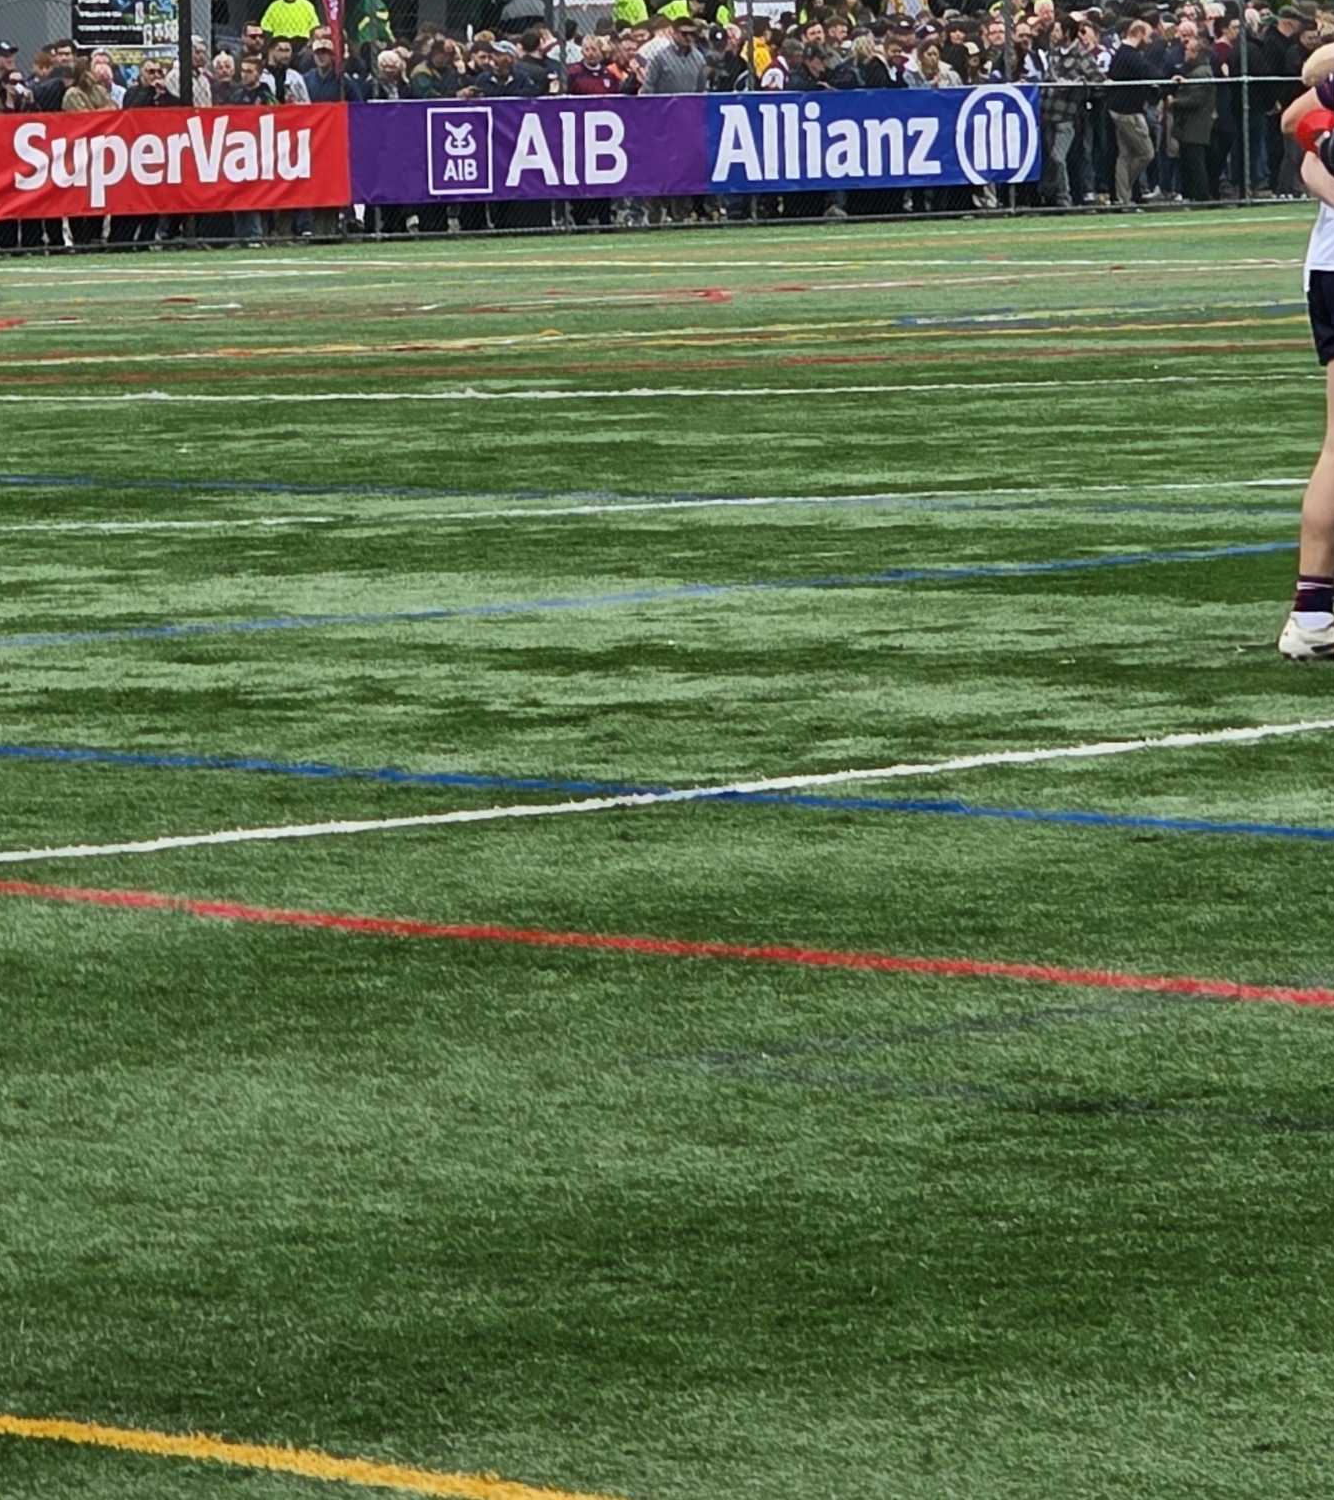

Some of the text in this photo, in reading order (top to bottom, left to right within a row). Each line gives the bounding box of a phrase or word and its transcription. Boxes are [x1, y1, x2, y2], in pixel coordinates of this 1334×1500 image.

[13, 113, 312, 208] SuperValu
[443, 158, 478, 182] AIB
[504, 110, 628, 187] AIB
[711, 101, 942, 183] Allianz
